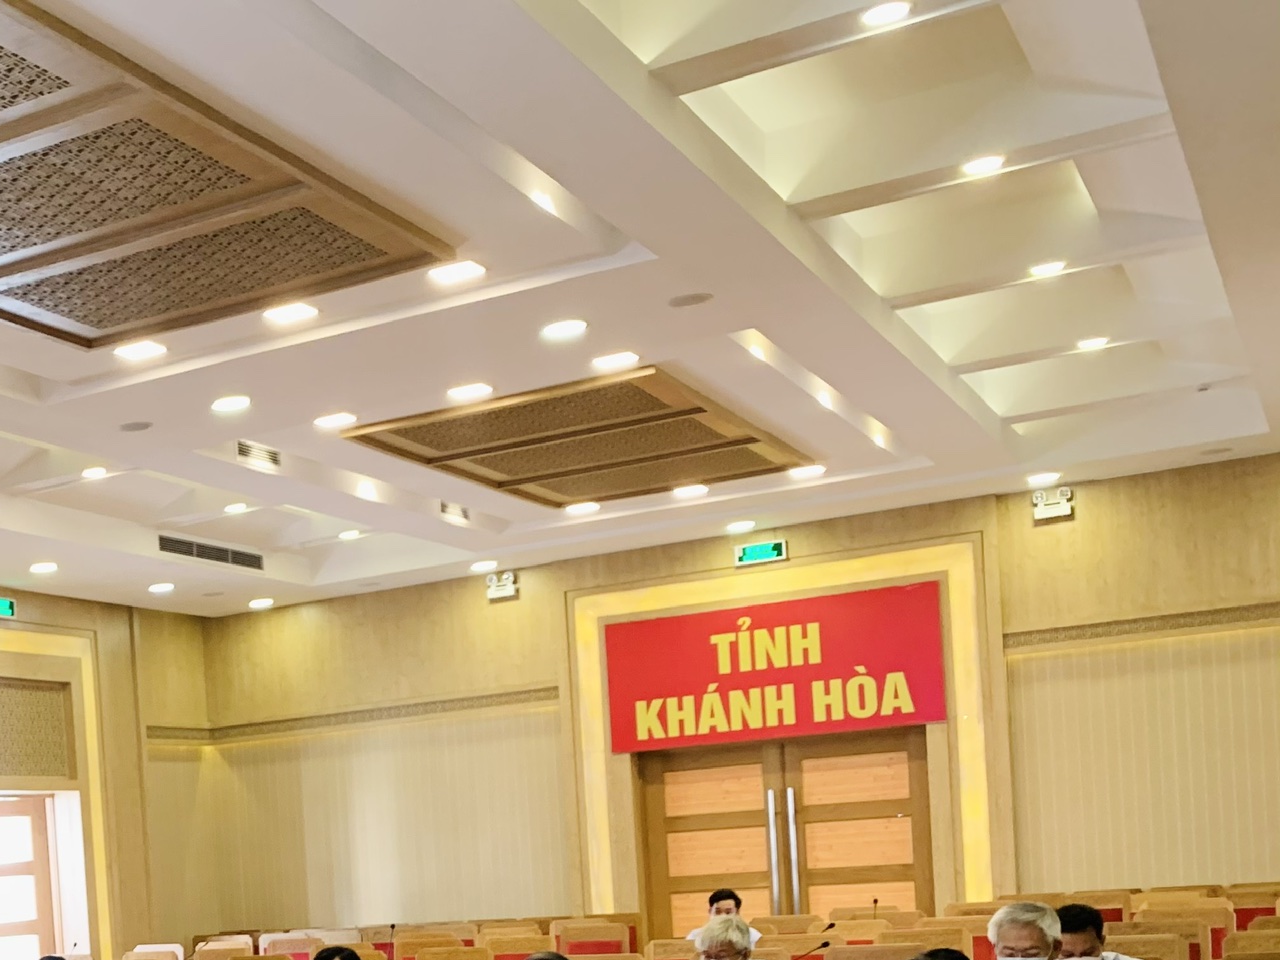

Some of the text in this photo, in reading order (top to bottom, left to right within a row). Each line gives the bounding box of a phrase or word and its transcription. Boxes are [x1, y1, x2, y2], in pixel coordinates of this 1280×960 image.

[709, 616, 822, 675] TỈNH
[634, 665, 915, 741] KHÁNH HÒA
